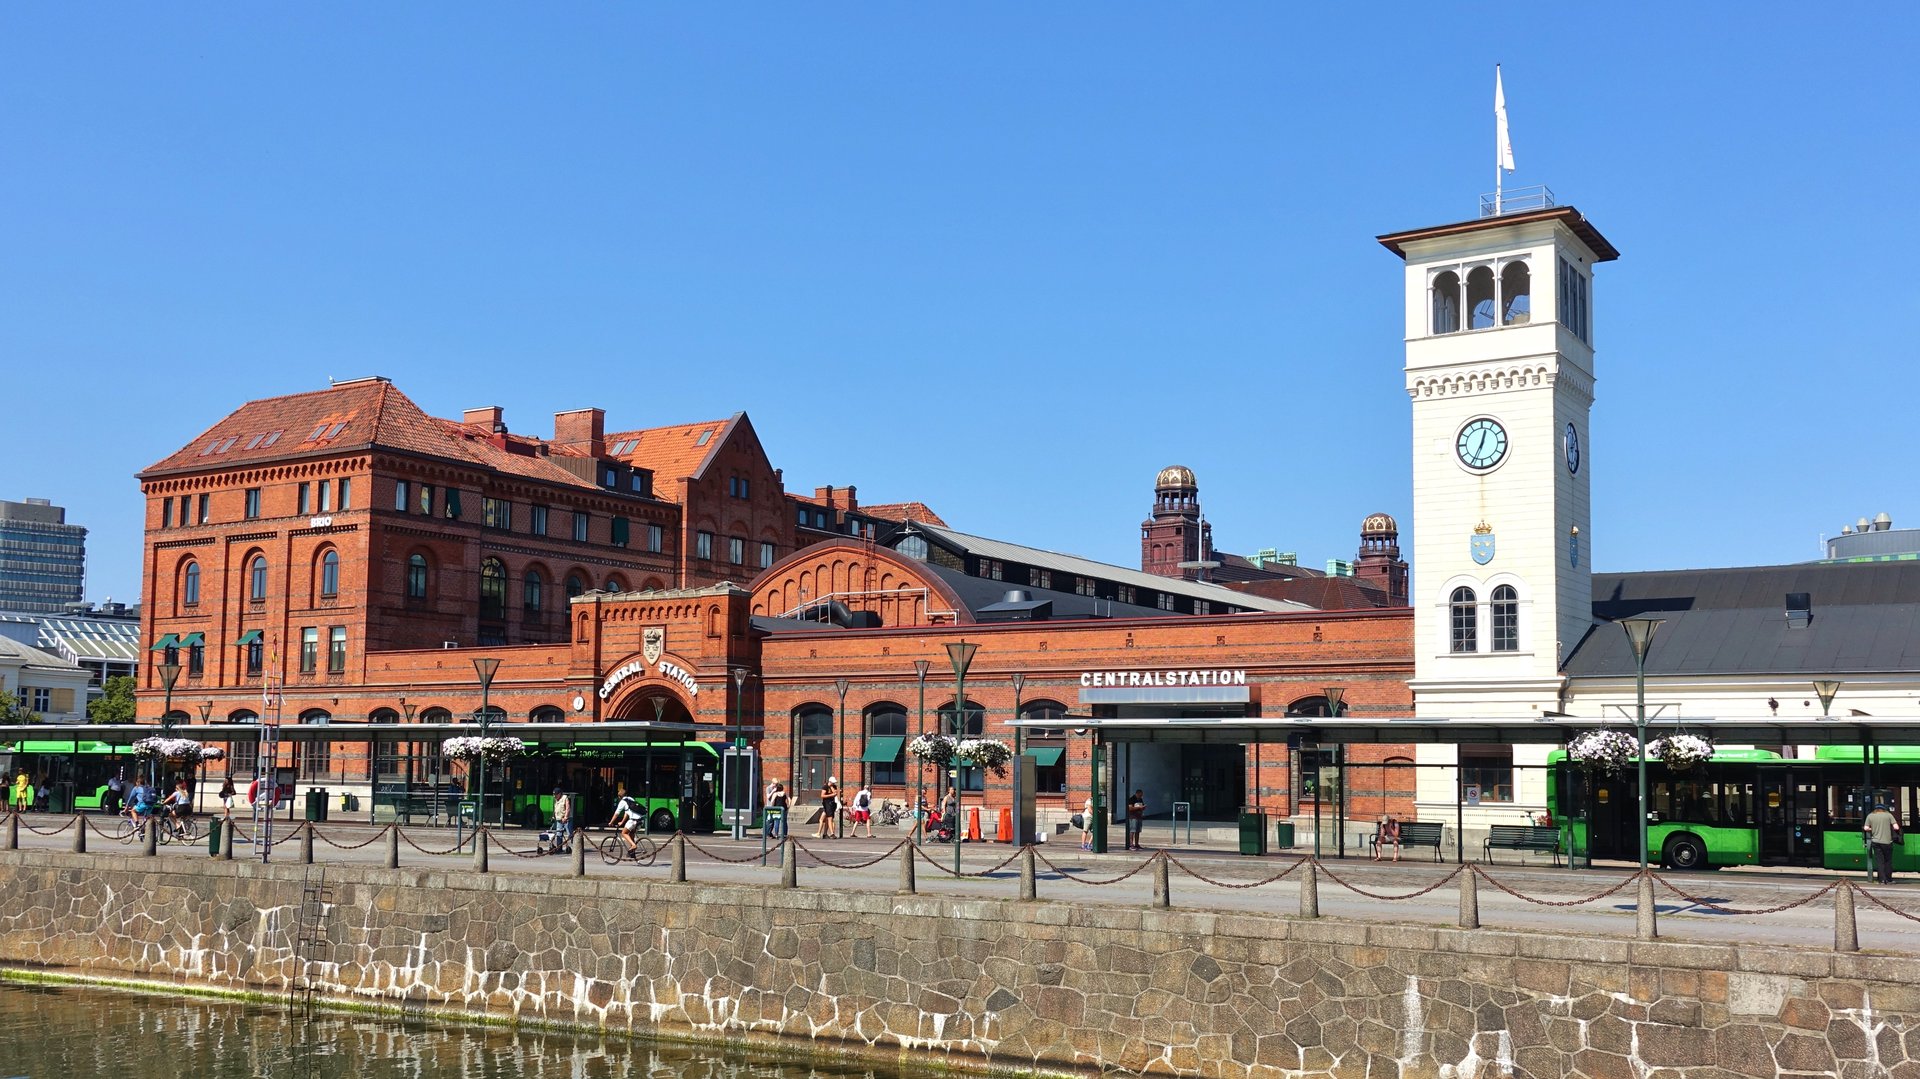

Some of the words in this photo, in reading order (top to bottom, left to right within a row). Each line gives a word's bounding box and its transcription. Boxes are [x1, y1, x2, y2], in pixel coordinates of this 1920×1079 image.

[599, 661, 643, 699] CENTRAL
[659, 661, 699, 696] STATION
[1080, 670, 1246, 686] CENTRALSTATION
[1082, 750, 1088, 759] 6
